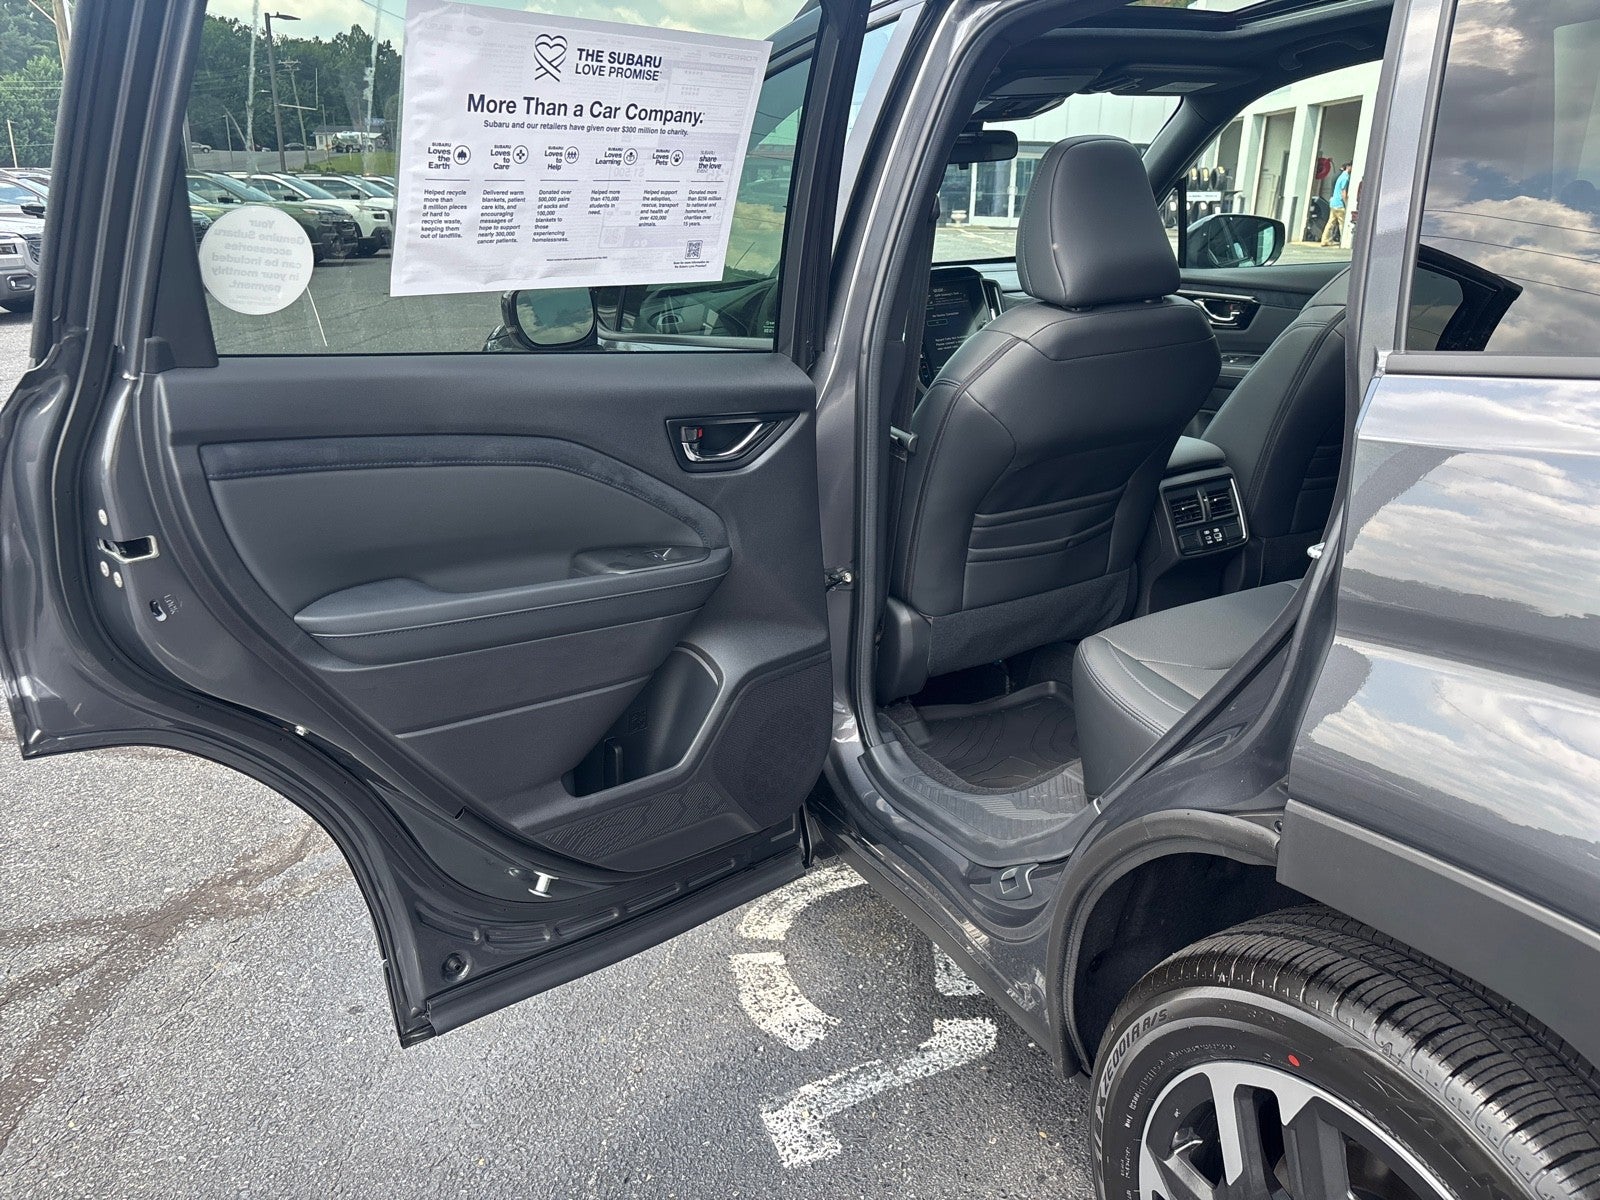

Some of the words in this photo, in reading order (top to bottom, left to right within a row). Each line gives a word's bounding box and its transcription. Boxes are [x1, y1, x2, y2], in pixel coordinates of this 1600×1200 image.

[577, 48, 604, 64] THE
[608, 52, 662, 68] SUBARU
[575, 63, 605, 76] LOVE
[608, 67, 660, 81] PROMISE
[467, 93, 516, 114] More
[523, 97, 567, 117] Than
[573, 103, 583, 117] a
[590, 101, 620, 120] Car
[625, 103, 703, 127] Company.
[484, 120, 509, 129] Subaru
[511, 121, 524, 129] and
[540, 121, 567, 130] retailers
[569, 122, 585, 131] have
[587, 124, 604, 133] given
[622, 125, 636, 134] $300
[667, 128, 688, 137] charity.
[428, 147, 451, 155] Loves
[596, 158, 621, 166] Learning
[446, 189, 466, 197] recycle
[1142, 1008, 1168, 1031] A/S
